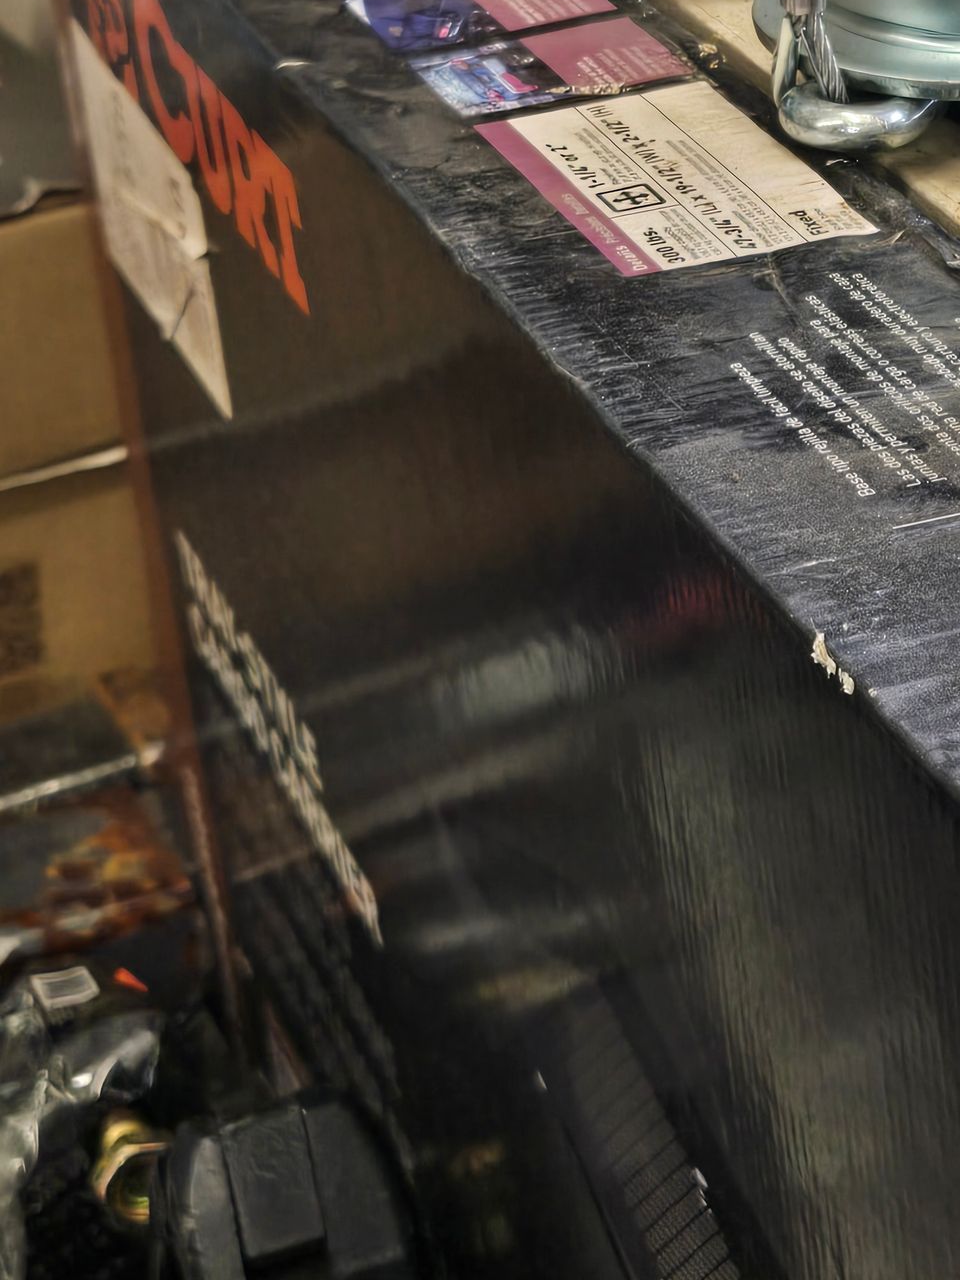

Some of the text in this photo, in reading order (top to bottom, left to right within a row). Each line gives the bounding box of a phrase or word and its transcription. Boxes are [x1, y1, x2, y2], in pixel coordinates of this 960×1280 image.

[587, 105, 613, 117] (H)
[559, 152, 578, 162] or
[635, 148, 664, 163] (W)
[694, 202, 721, 215] (L)
[788, 210, 828, 235] Fixed
[611, 244, 648, 270] Details
[635, 227, 686, 263] 300 lbs.
[828, 272, 854, 290] capa
[849, 290, 866, 300] de
[804, 295, 848, 329] elásticas
[861, 300, 906, 336] duradero
[809, 319, 839, 338] para
[778, 337, 812, 363] rápido
[830, 338, 871, 371] montaje
[842, 328, 882, 359] correas
[900, 336, 928, 353] muy
[805, 362, 848, 396] montaje
[866, 370, 884, 382] de
[885, 366, 916, 390] carga
[842, 396, 860, 407] un
[878, 382, 921, 415] orificios
[912, 390, 930, 401] de
[748, 332, 921, 487] Las dos piezas del diseño se atornillan
[922, 401, 949, 416] red
[730, 362, 876, 497] Base tipo rejilla de fácil limpieza
[855, 408, 908, 447] permiten
[916, 415, 940, 432] dos
[905, 454, 948, 483] juntas
